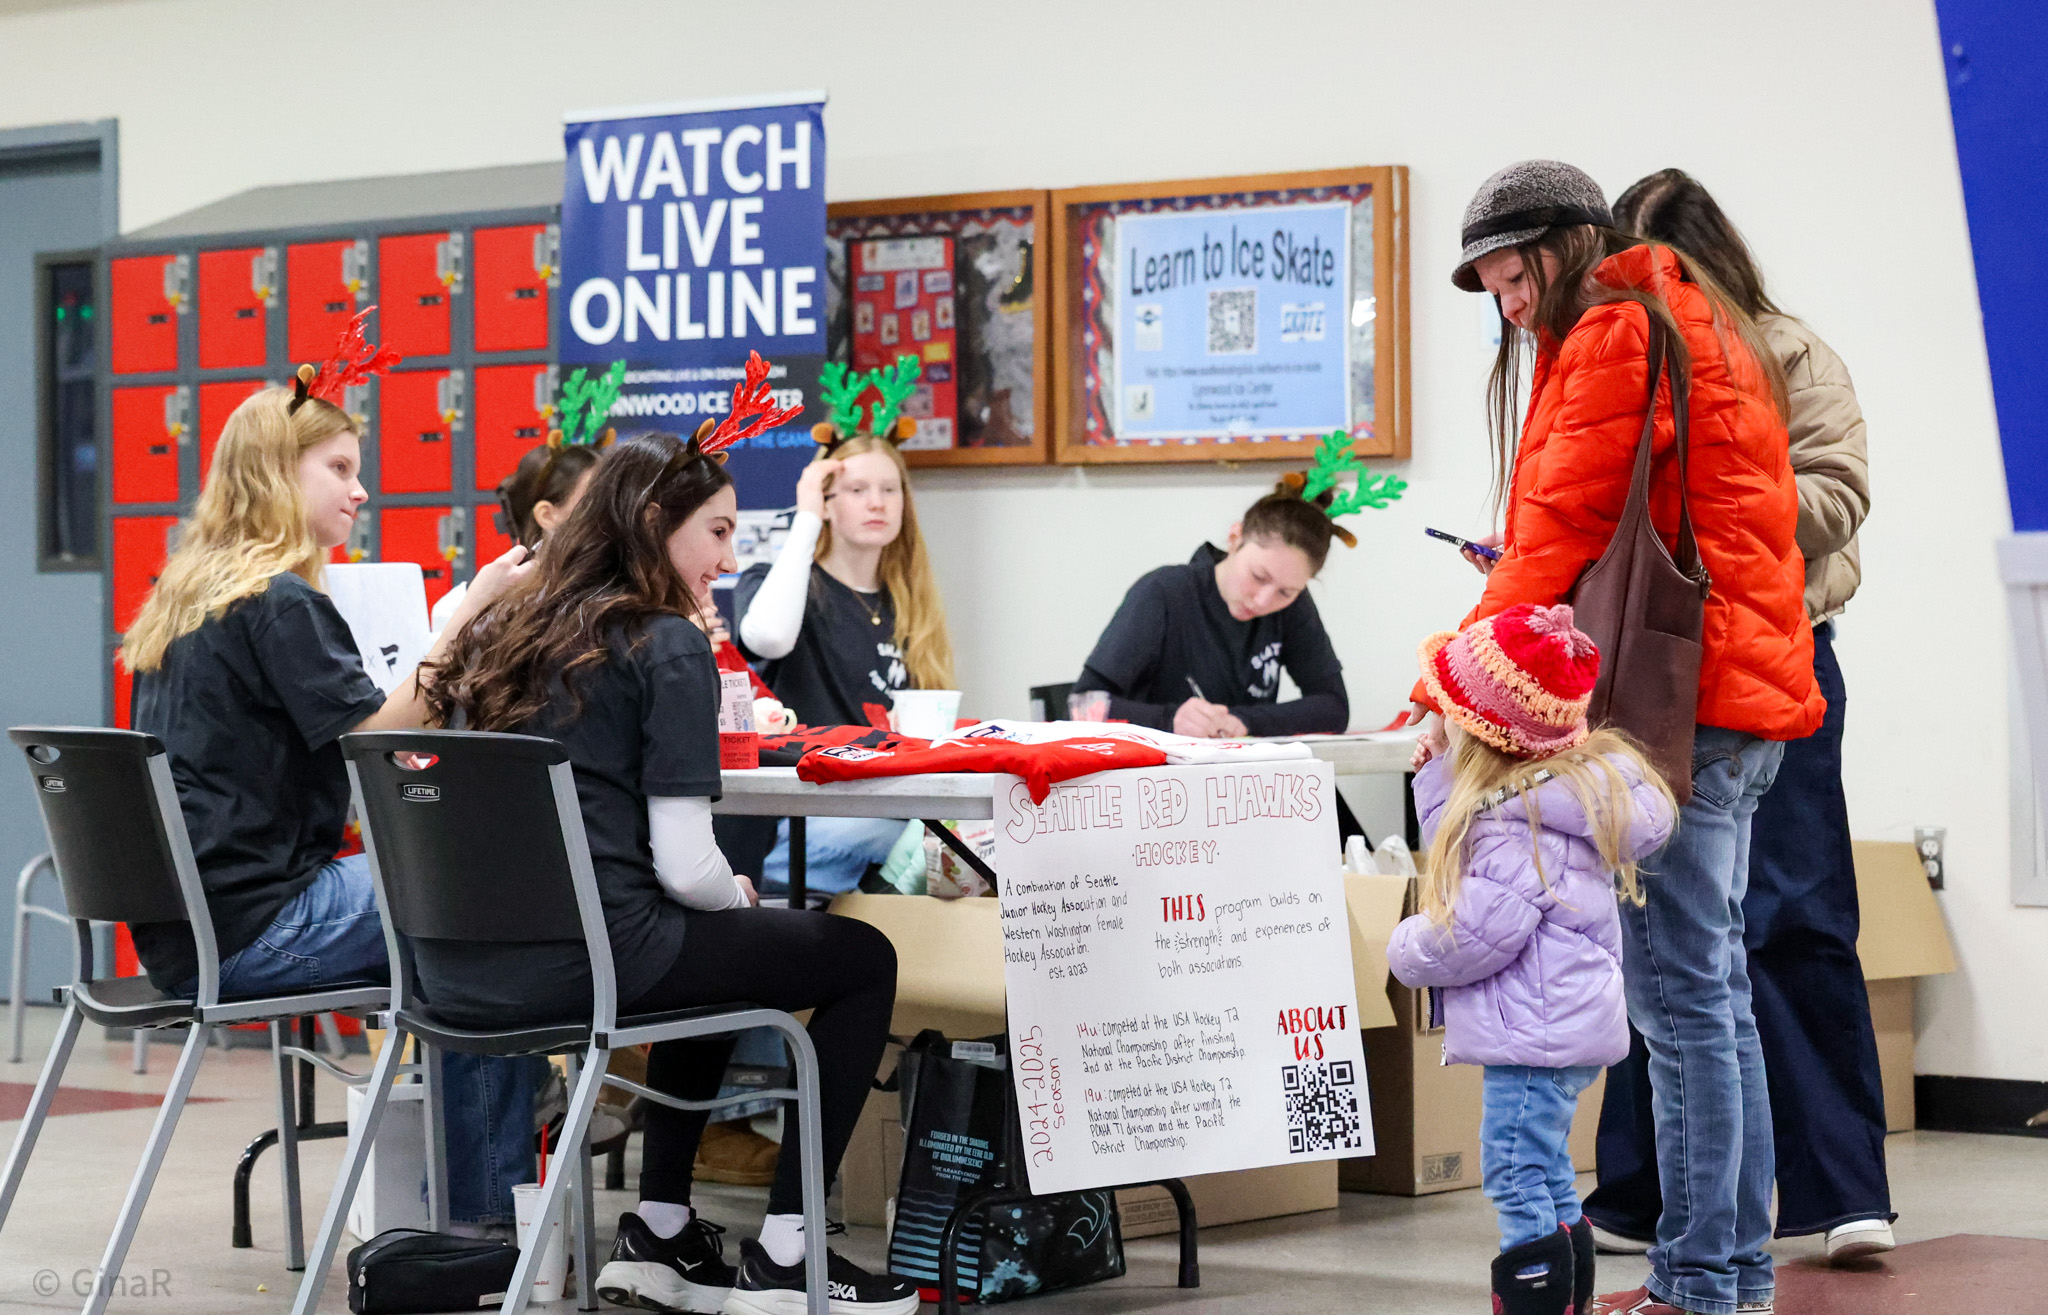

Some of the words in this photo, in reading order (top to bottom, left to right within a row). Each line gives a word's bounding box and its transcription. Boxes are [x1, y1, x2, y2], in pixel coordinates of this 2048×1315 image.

[579, 121, 812, 203] WATCH
[626, 196, 764, 271] LIVE
[1131, 248, 1196, 295] Learn
[1203, 232, 1224, 281] to
[1230, 225, 1264, 278] Ice
[1272, 229, 1335, 287] Skate
[569, 266, 816, 345] ONLINE
[698, 391, 730, 414] ICE
[408, 787, 436, 796] LIFETIME
[1006, 782, 1123, 843] SEATTLE
[1137, 777, 1188, 829] RED
[1205, 773, 1322, 828] HAWKS
[1135, 840, 1217, 867] HOCKEY
[1005, 878, 1012, 896] A
[1016, 880, 1065, 896] combination
[1070, 875, 1080, 890] of
[1085, 873, 1118, 888] Seattle
[1000, 903, 1028, 919] Junior
[1032, 901, 1056, 921] Hockey
[1061, 896, 1107, 913] Association
[1112, 892, 1128, 907] and
[1160, 893, 1205, 922] THIS
[1214, 896, 1262, 924] program
[1269, 892, 1300, 907] builds
[1308, 892, 1323, 903] on
[1002, 926, 1041, 941] Western
[1045, 922, 1091, 943] Washington
[1155, 932, 1171, 949] the
[1230, 929, 1247, 944] and
[1318, 916, 1331, 932] of
[1004, 946, 1037, 971] Hockey
[1041, 943, 1089, 960] Association.
[1049, 966, 1065, 979] est.
[1069, 962, 1088, 976] 2023
[1158, 960, 1183, 979] both
[1102, 1016, 1138, 1038] competed
[1141, 1014, 1150, 1030] at
[1153, 1014, 1168, 1030] the
[1173, 1011, 1190, 1026] USA
[1193, 1011, 1221, 1032] Hockey
[1224, 1007, 1239, 1022] T2
[1278, 1005, 1347, 1035] ABOUT
[1081, 1041, 1113, 1058] National
[1116, 1038, 1167, 1055] Championship
[1174, 1034, 1195, 1049] after
[1200, 1030, 1236, 1048] finishing
[1294, 1033, 1324, 1061] US
[1083, 1061, 1099, 1074] 2nd
[1104, 1060, 1114, 1071] at
[1119, 1057, 1132, 1070] the
[1136, 1053, 1162, 1069] Pacific
[1165, 1051, 1194, 1066] District
[1019, 1025, 1053, 1168] 2024-2025
[1108, 1084, 1142, 1102] competed
[1143, 1084, 1152, 1097] at
[1155, 1083, 1169, 1096] the
[1171, 1081, 1188, 1094] USA
[1190, 1079, 1216, 1099] Hockey
[1087, 1106, 1119, 1123] National
[1122, 1104, 1166, 1121] Championship
[1170, 1101, 1191, 1115] after
[1193, 1098, 1222, 1116] winning
[1229, 1094, 1241, 1109] the
[1126, 1122, 1155, 1136] division
[1158, 1119, 1174, 1131] and
[1177, 1118, 1190, 1130] the
[1195, 1114, 1226, 1129] Pacific
[919, 1139, 954, 1152] ILLUMINATED
[954, 1145, 963, 1154] BY
[958, 1135, 968, 1145] THE
[1092, 1140, 1126, 1155] District
[827, 1281, 857, 1300] OKA
